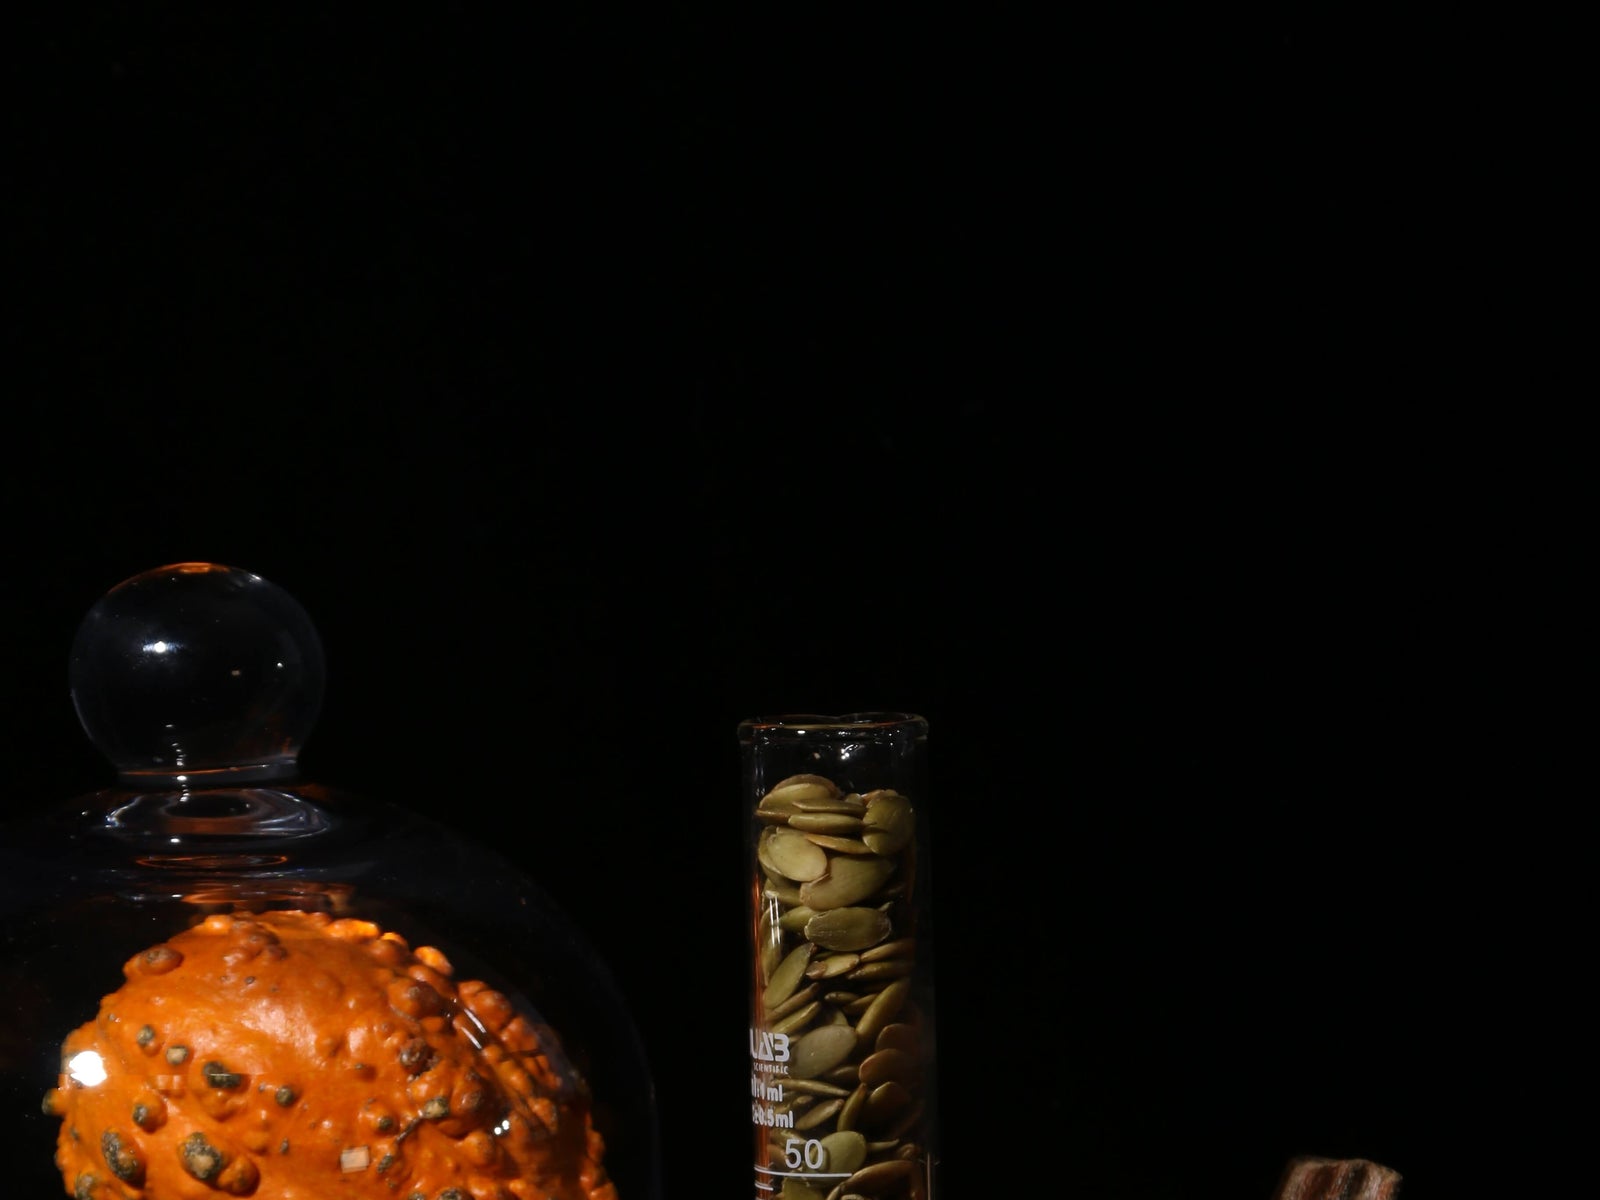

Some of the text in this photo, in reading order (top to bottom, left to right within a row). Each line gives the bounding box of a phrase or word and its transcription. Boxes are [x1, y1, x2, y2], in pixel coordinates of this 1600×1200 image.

[749, 1028, 790, 1062] LAB
[767, 1084, 783, 1102] ml
[775, 1110, 794, 1128] ml
[785, 1138, 824, 1169] 50
